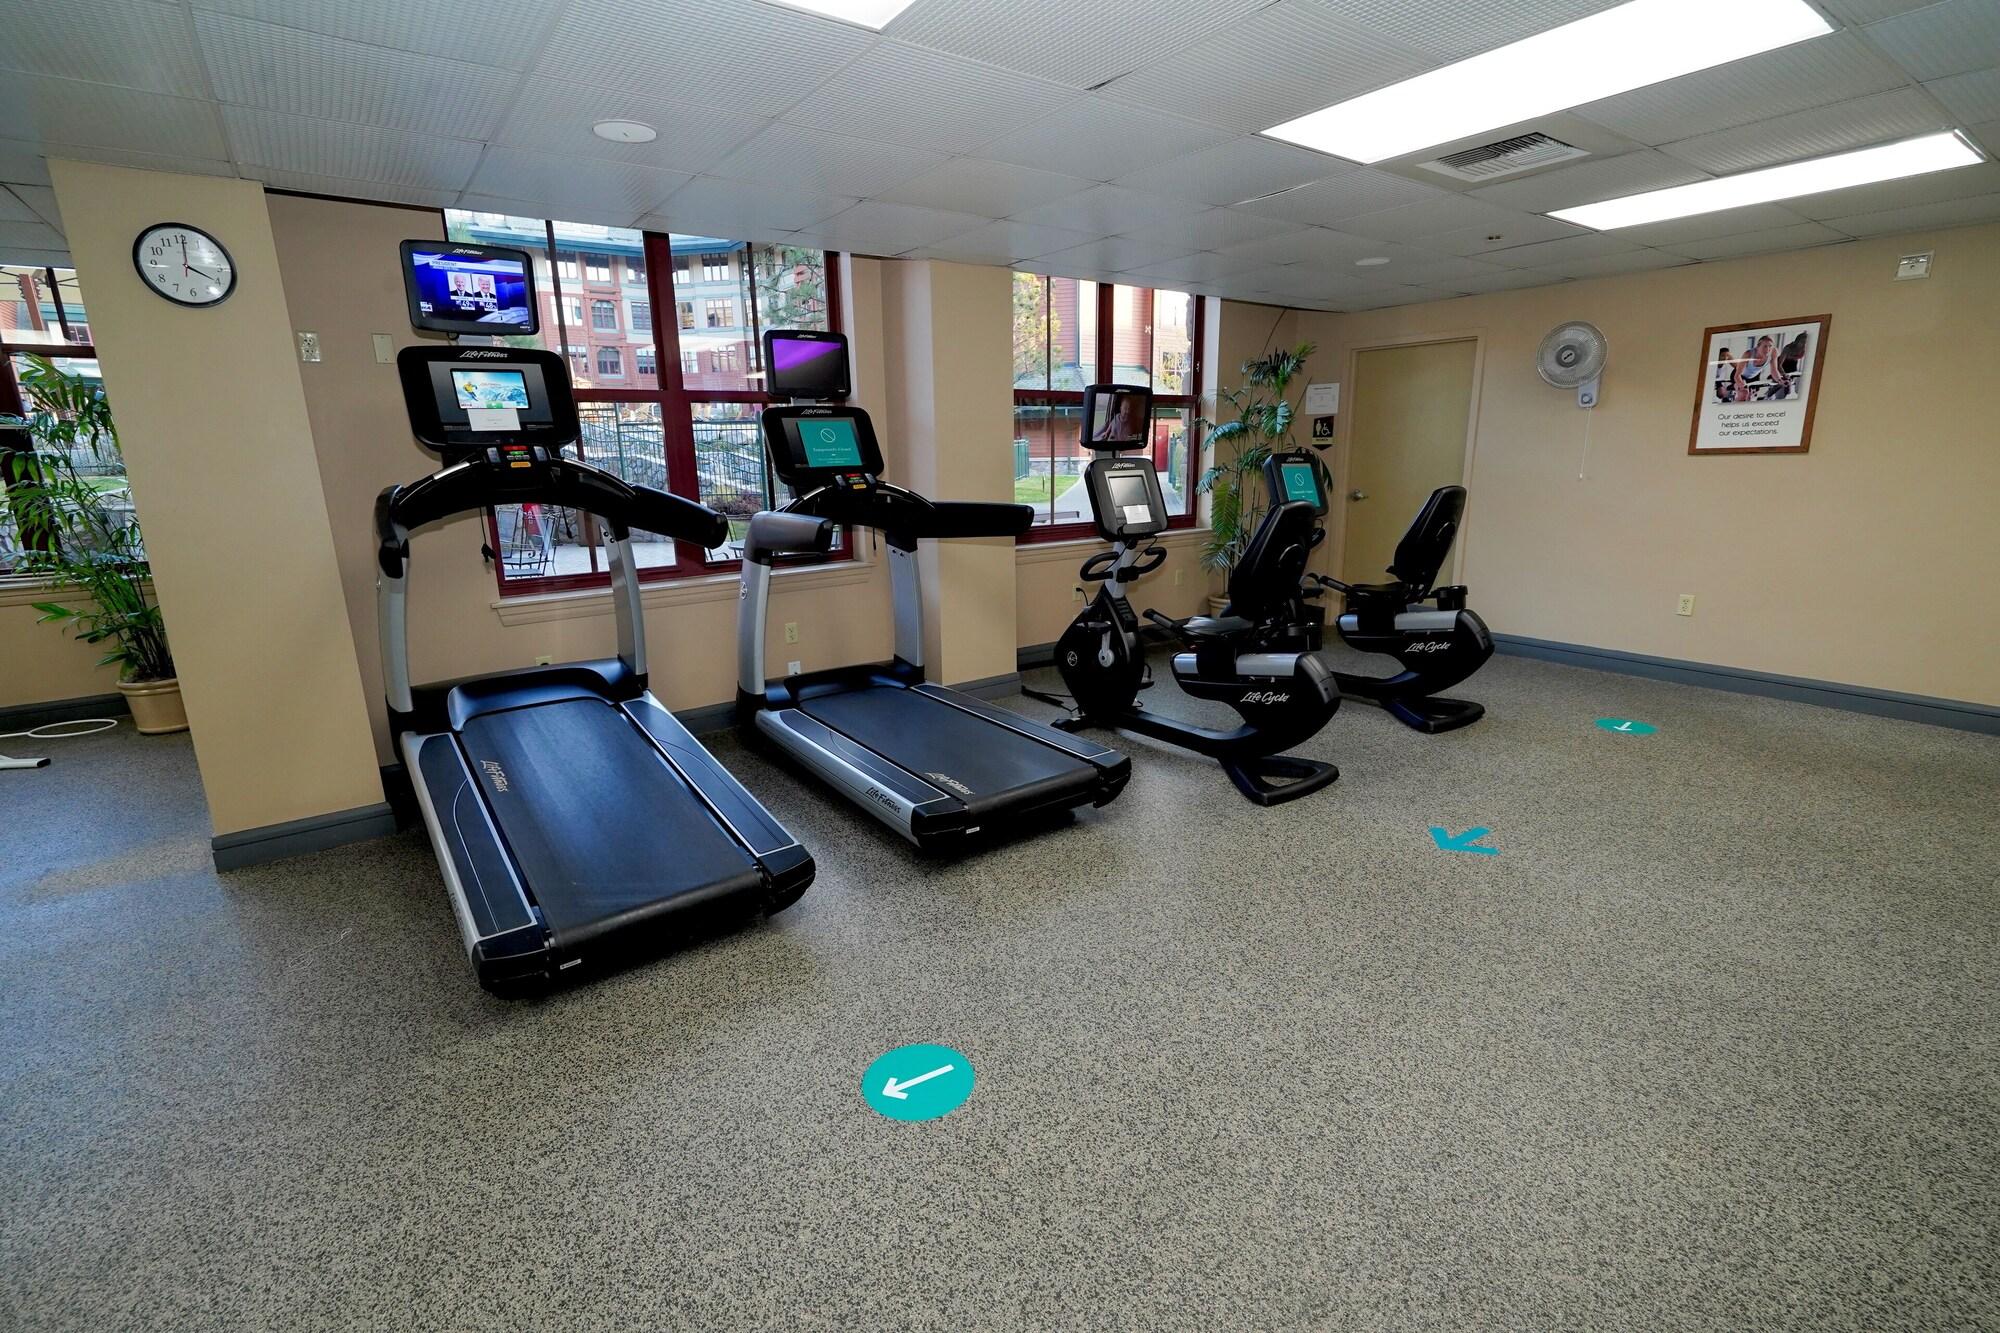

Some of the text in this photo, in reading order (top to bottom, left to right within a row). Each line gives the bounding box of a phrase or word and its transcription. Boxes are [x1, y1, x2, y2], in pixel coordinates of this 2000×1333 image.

[160, 237, 172, 248] 11
[174, 234, 188, 245] 12
[150, 246, 163, 257] 10
[150, 259, 158, 268] 9
[158, 273, 166, 283] 8
[214, 277, 222, 287] 4
[172, 283, 179, 293] 7
[189, 287, 198, 297] 6
[1405, 641, 1451, 653] Life Cycle
[1240, 691, 1290, 705] Life Cycle
